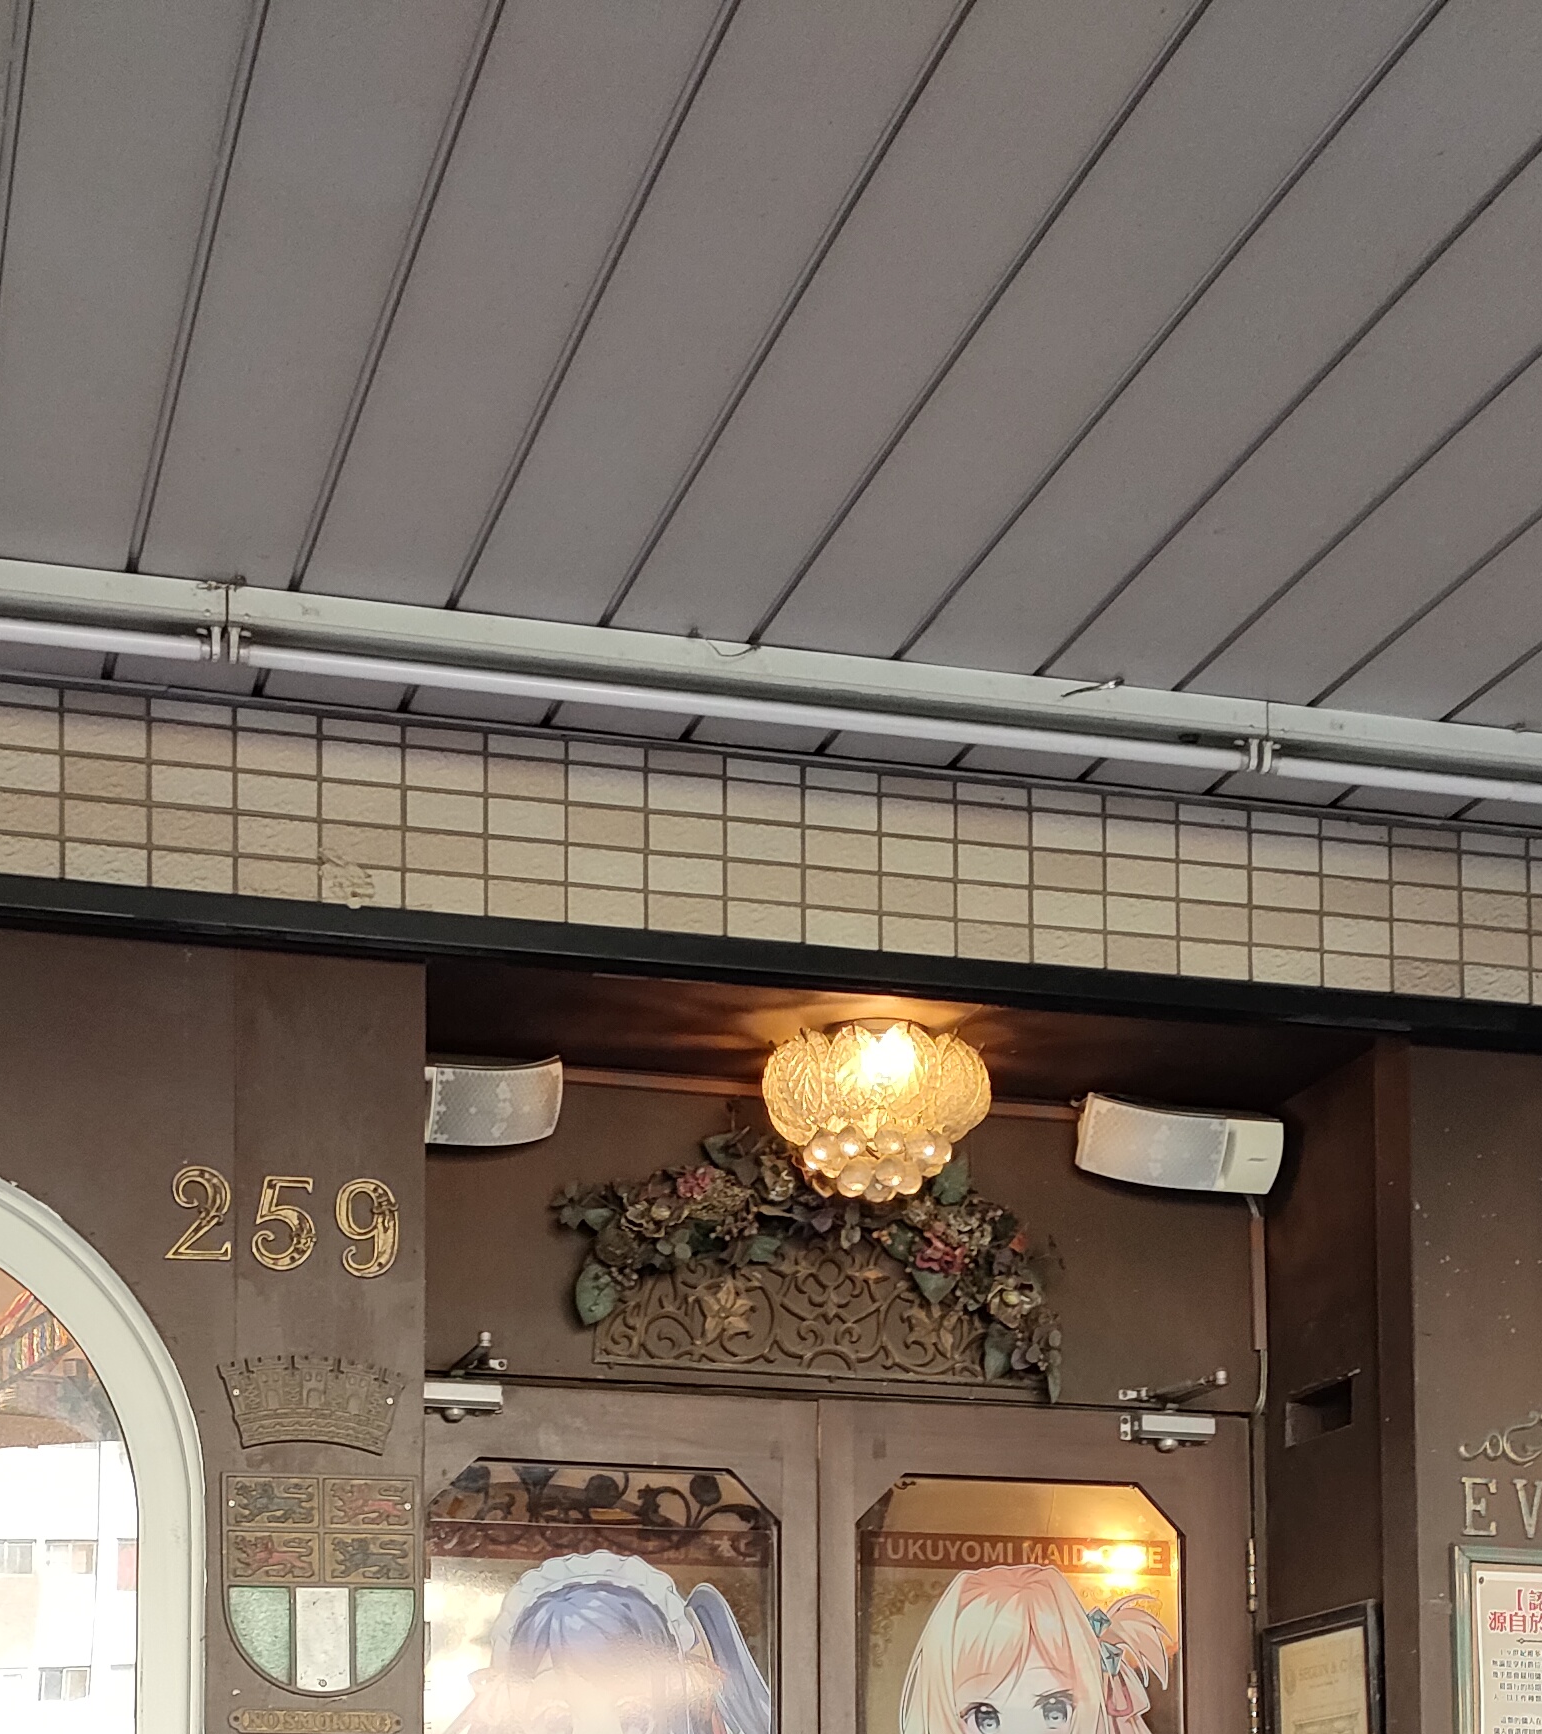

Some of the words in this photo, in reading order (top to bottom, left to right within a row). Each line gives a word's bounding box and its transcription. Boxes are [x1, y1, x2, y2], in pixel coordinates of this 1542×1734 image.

[164, 1165, 399, 1278] 259
[870, 1537, 1014, 1563] TUKUYOMI
[1022, 1542, 1087, 1566] MAID
